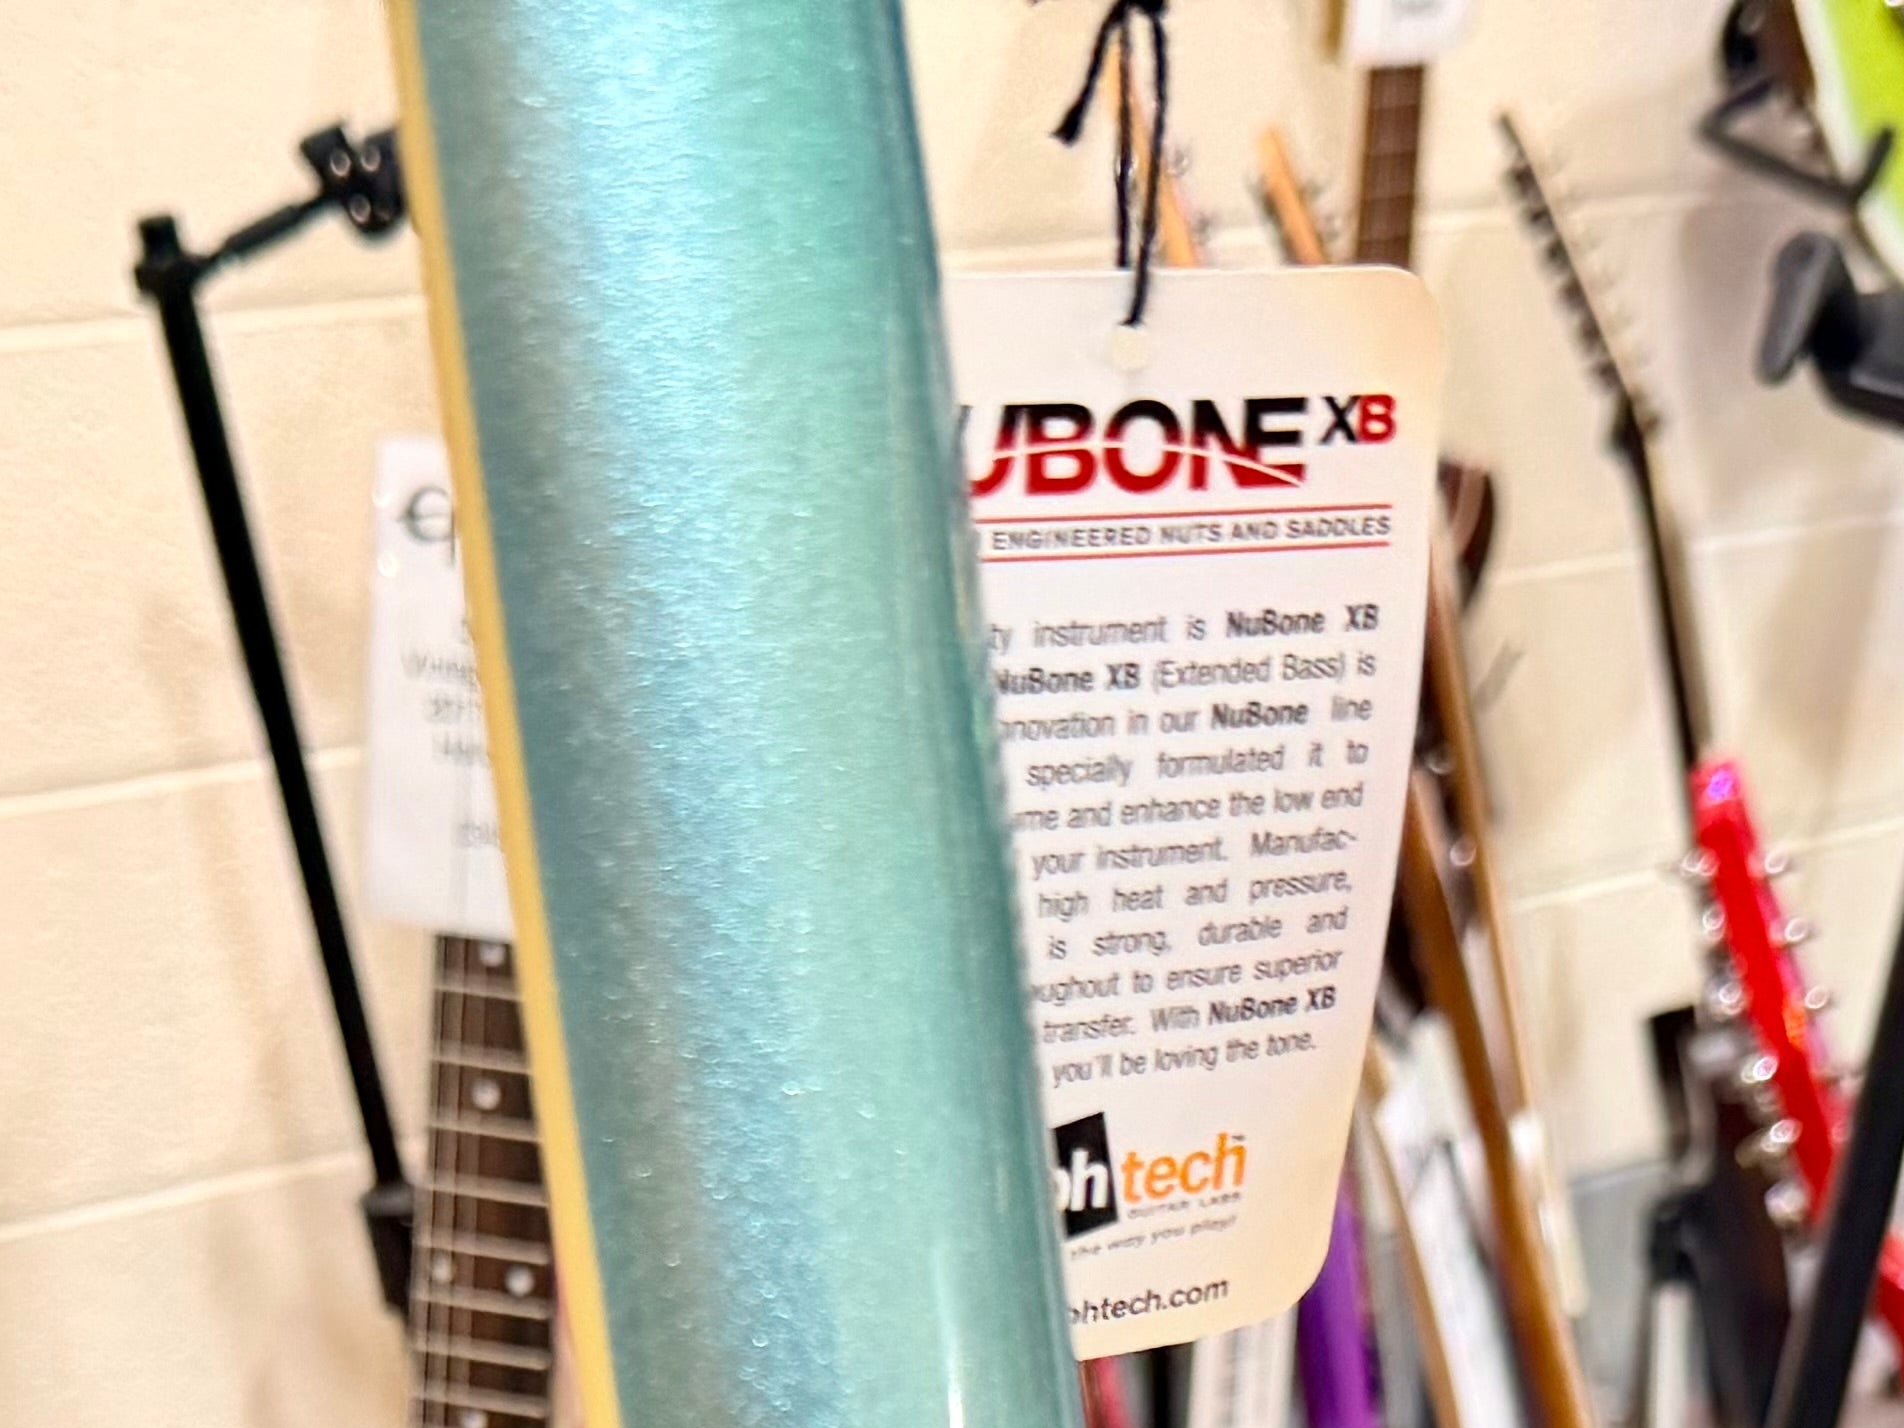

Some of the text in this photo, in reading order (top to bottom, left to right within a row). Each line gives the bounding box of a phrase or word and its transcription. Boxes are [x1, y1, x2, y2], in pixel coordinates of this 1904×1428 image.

[1320, 393, 1396, 446] XB
[993, 515, 1392, 551] ENGINEERED NUTS AND SADDLES
[1034, 616, 1168, 648] instrument
[1187, 615, 1207, 641] is
[1226, 609, 1325, 638] NuBone
[1345, 603, 1379, 632] XB
[1105, 662, 1141, 691] XB
[1152, 657, 1273, 693] (Extended
[1282, 651, 1346, 682] Bass)
[1358, 650, 1377, 676] is
[1127, 709, 1149, 737] in
[1159, 708, 1200, 733] our
[1211, 701, 1309, 730] NuBone
[1330, 695, 1373, 722] line
[1026, 739, 1369, 788] specially formulated it to
[1066, 802, 1112, 829] and
[1120, 797, 1221, 826] enhance
[1229, 791, 1265, 816] the
[1273, 788, 1314, 813] low
[1321, 782, 1364, 809] end
[1031, 827, 1357, 881] your instrument. Manufac-
[1037, 869, 1352, 923] high heat and pressure,
[1048, 935, 1067, 960] is
[1198, 916, 1283, 946] durable
[1306, 905, 1349, 934] and
[1132, 970, 1154, 996] to
[1166, 962, 1243, 991] ensure
[1252, 949, 1343, 983] superior
[1150, 1005, 1200, 1032] With
[1208, 995, 1298, 1026] NuBone
[1304, 985, 1336, 1012] XB
[1119, 1051, 1146, 1077] be
[1154, 1045, 1218, 1072] loving
[1225, 1037, 1260, 1063] the
[1265, 1030, 1317, 1057] tone.
